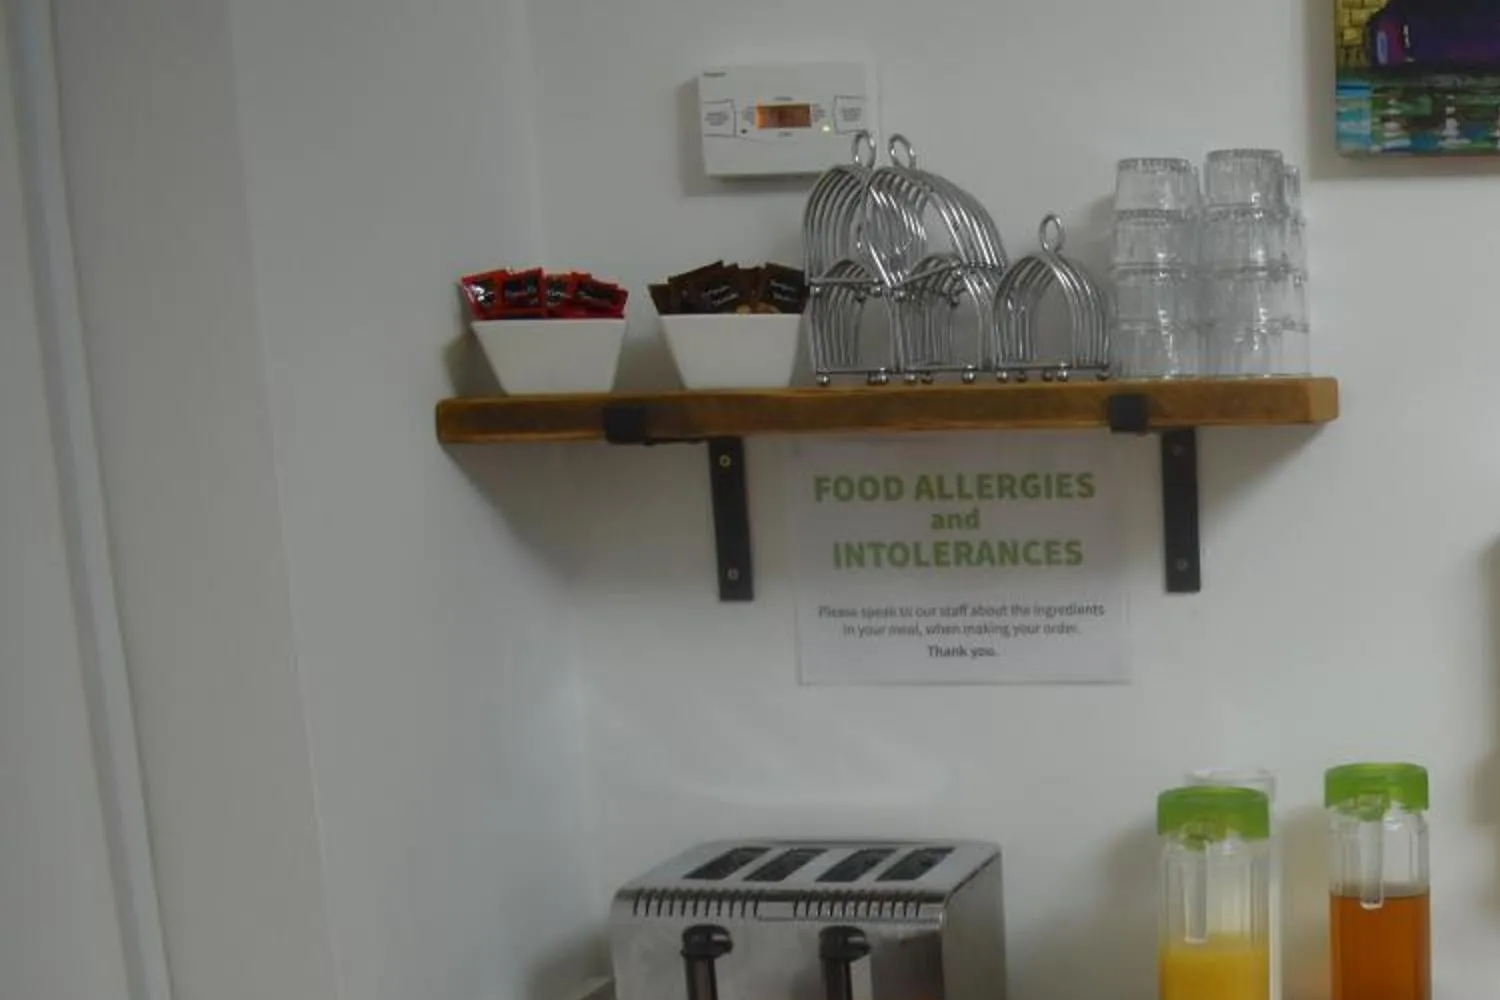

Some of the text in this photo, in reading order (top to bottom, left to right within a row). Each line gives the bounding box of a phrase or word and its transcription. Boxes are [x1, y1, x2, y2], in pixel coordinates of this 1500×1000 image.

[814, 471, 1096, 502] FOOD ALLERGIES
[930, 507, 980, 531] and
[832, 539, 1084, 568] INTOLERANCES
[818, 602, 1105, 620] Please speak to our staff about the ingredients
[858, 625, 886, 639] your
[888, 623, 923, 637] meal,
[925, 623, 961, 635] when
[962, 623, 1010, 638] making
[1012, 625, 1040, 638] your
[1042, 622, 1080, 635] order.
[928, 644, 967, 657] Thank
